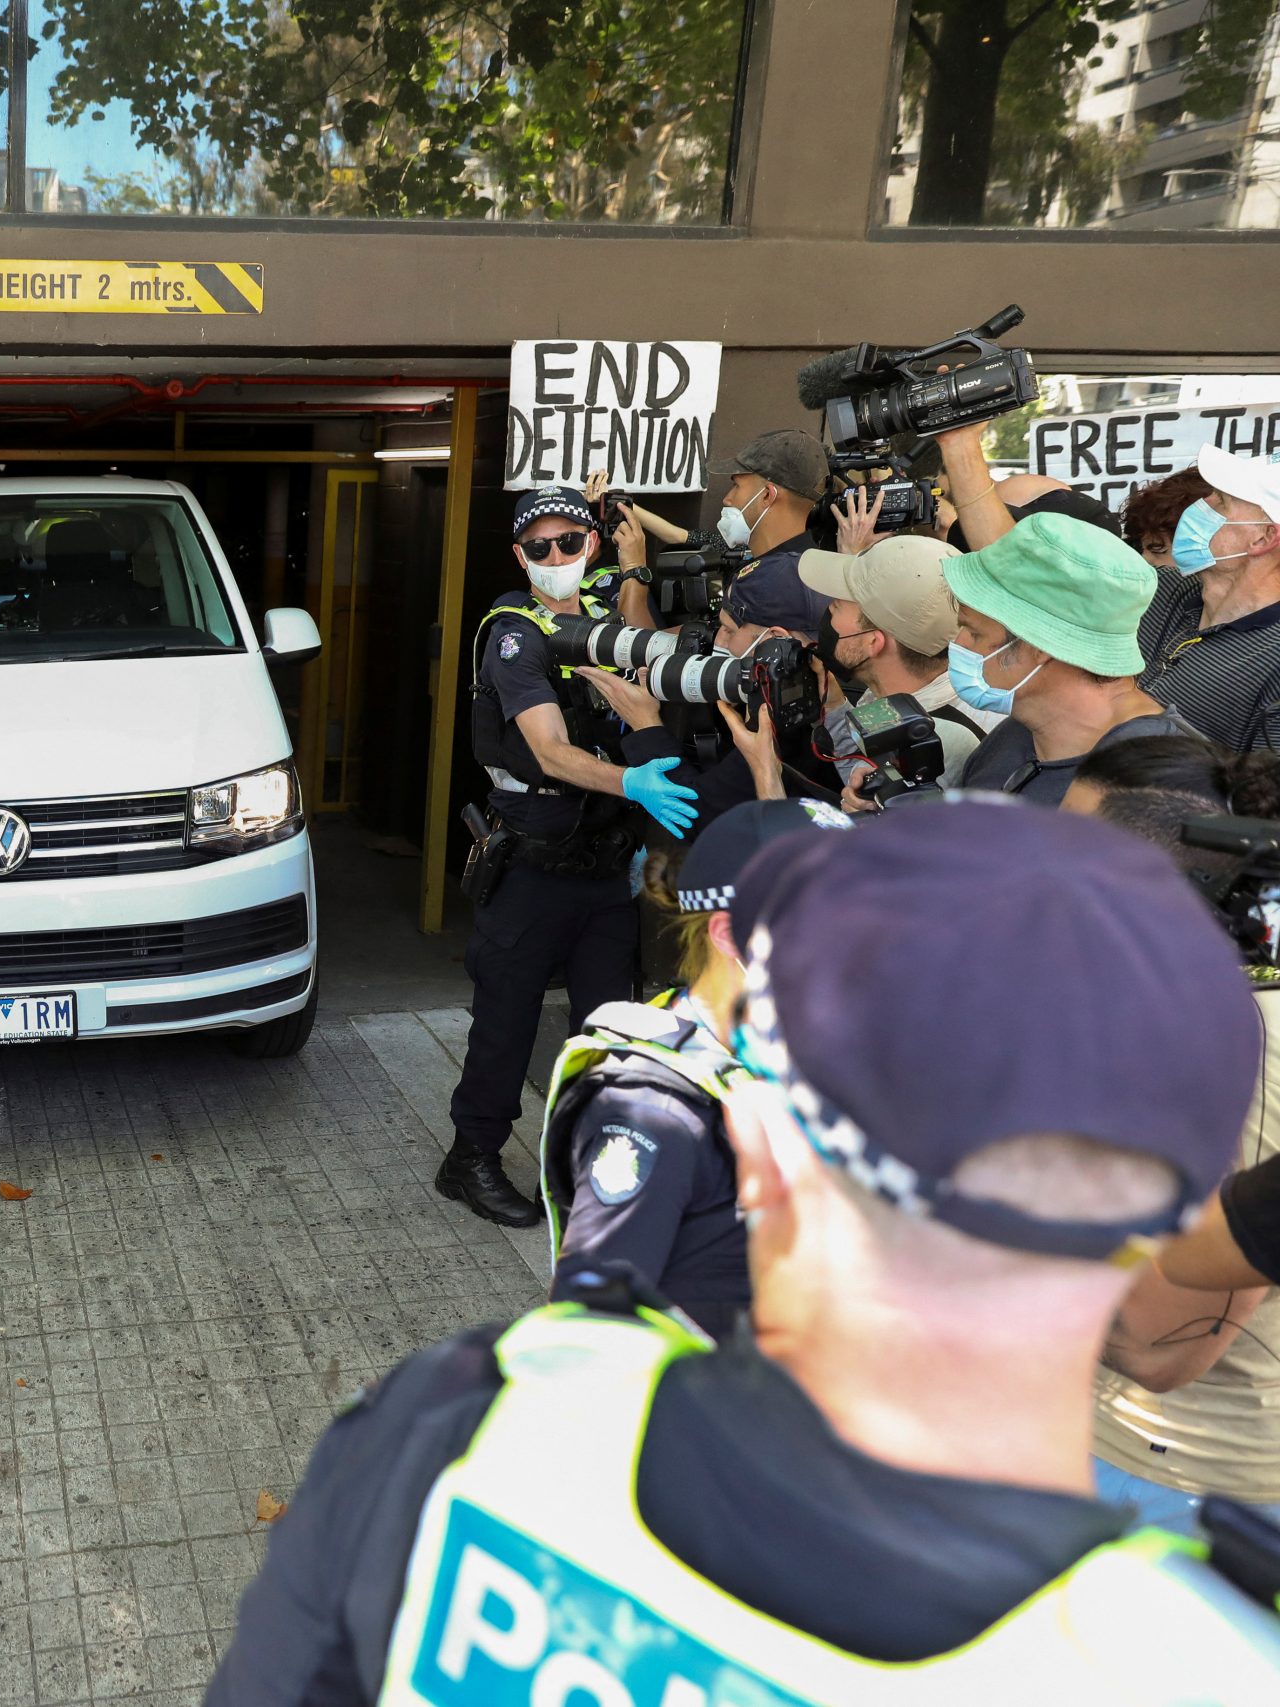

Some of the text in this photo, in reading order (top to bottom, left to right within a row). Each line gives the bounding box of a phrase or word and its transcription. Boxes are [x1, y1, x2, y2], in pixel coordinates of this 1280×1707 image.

[97, 274, 111, 300] 2
[130, 277, 193, 302] mtrs.
[535, 341, 690, 408] END
[984, 361, 1004, 371] SONY
[505, 404, 716, 488] DETENTION
[1036, 411, 1181, 477] FREE
[21, 1000, 70, 1030] 1RM
[4, 1031, 44, 1039] EDUCATION
[602, 1124, 658, 1153] VICTORIA POLICE
